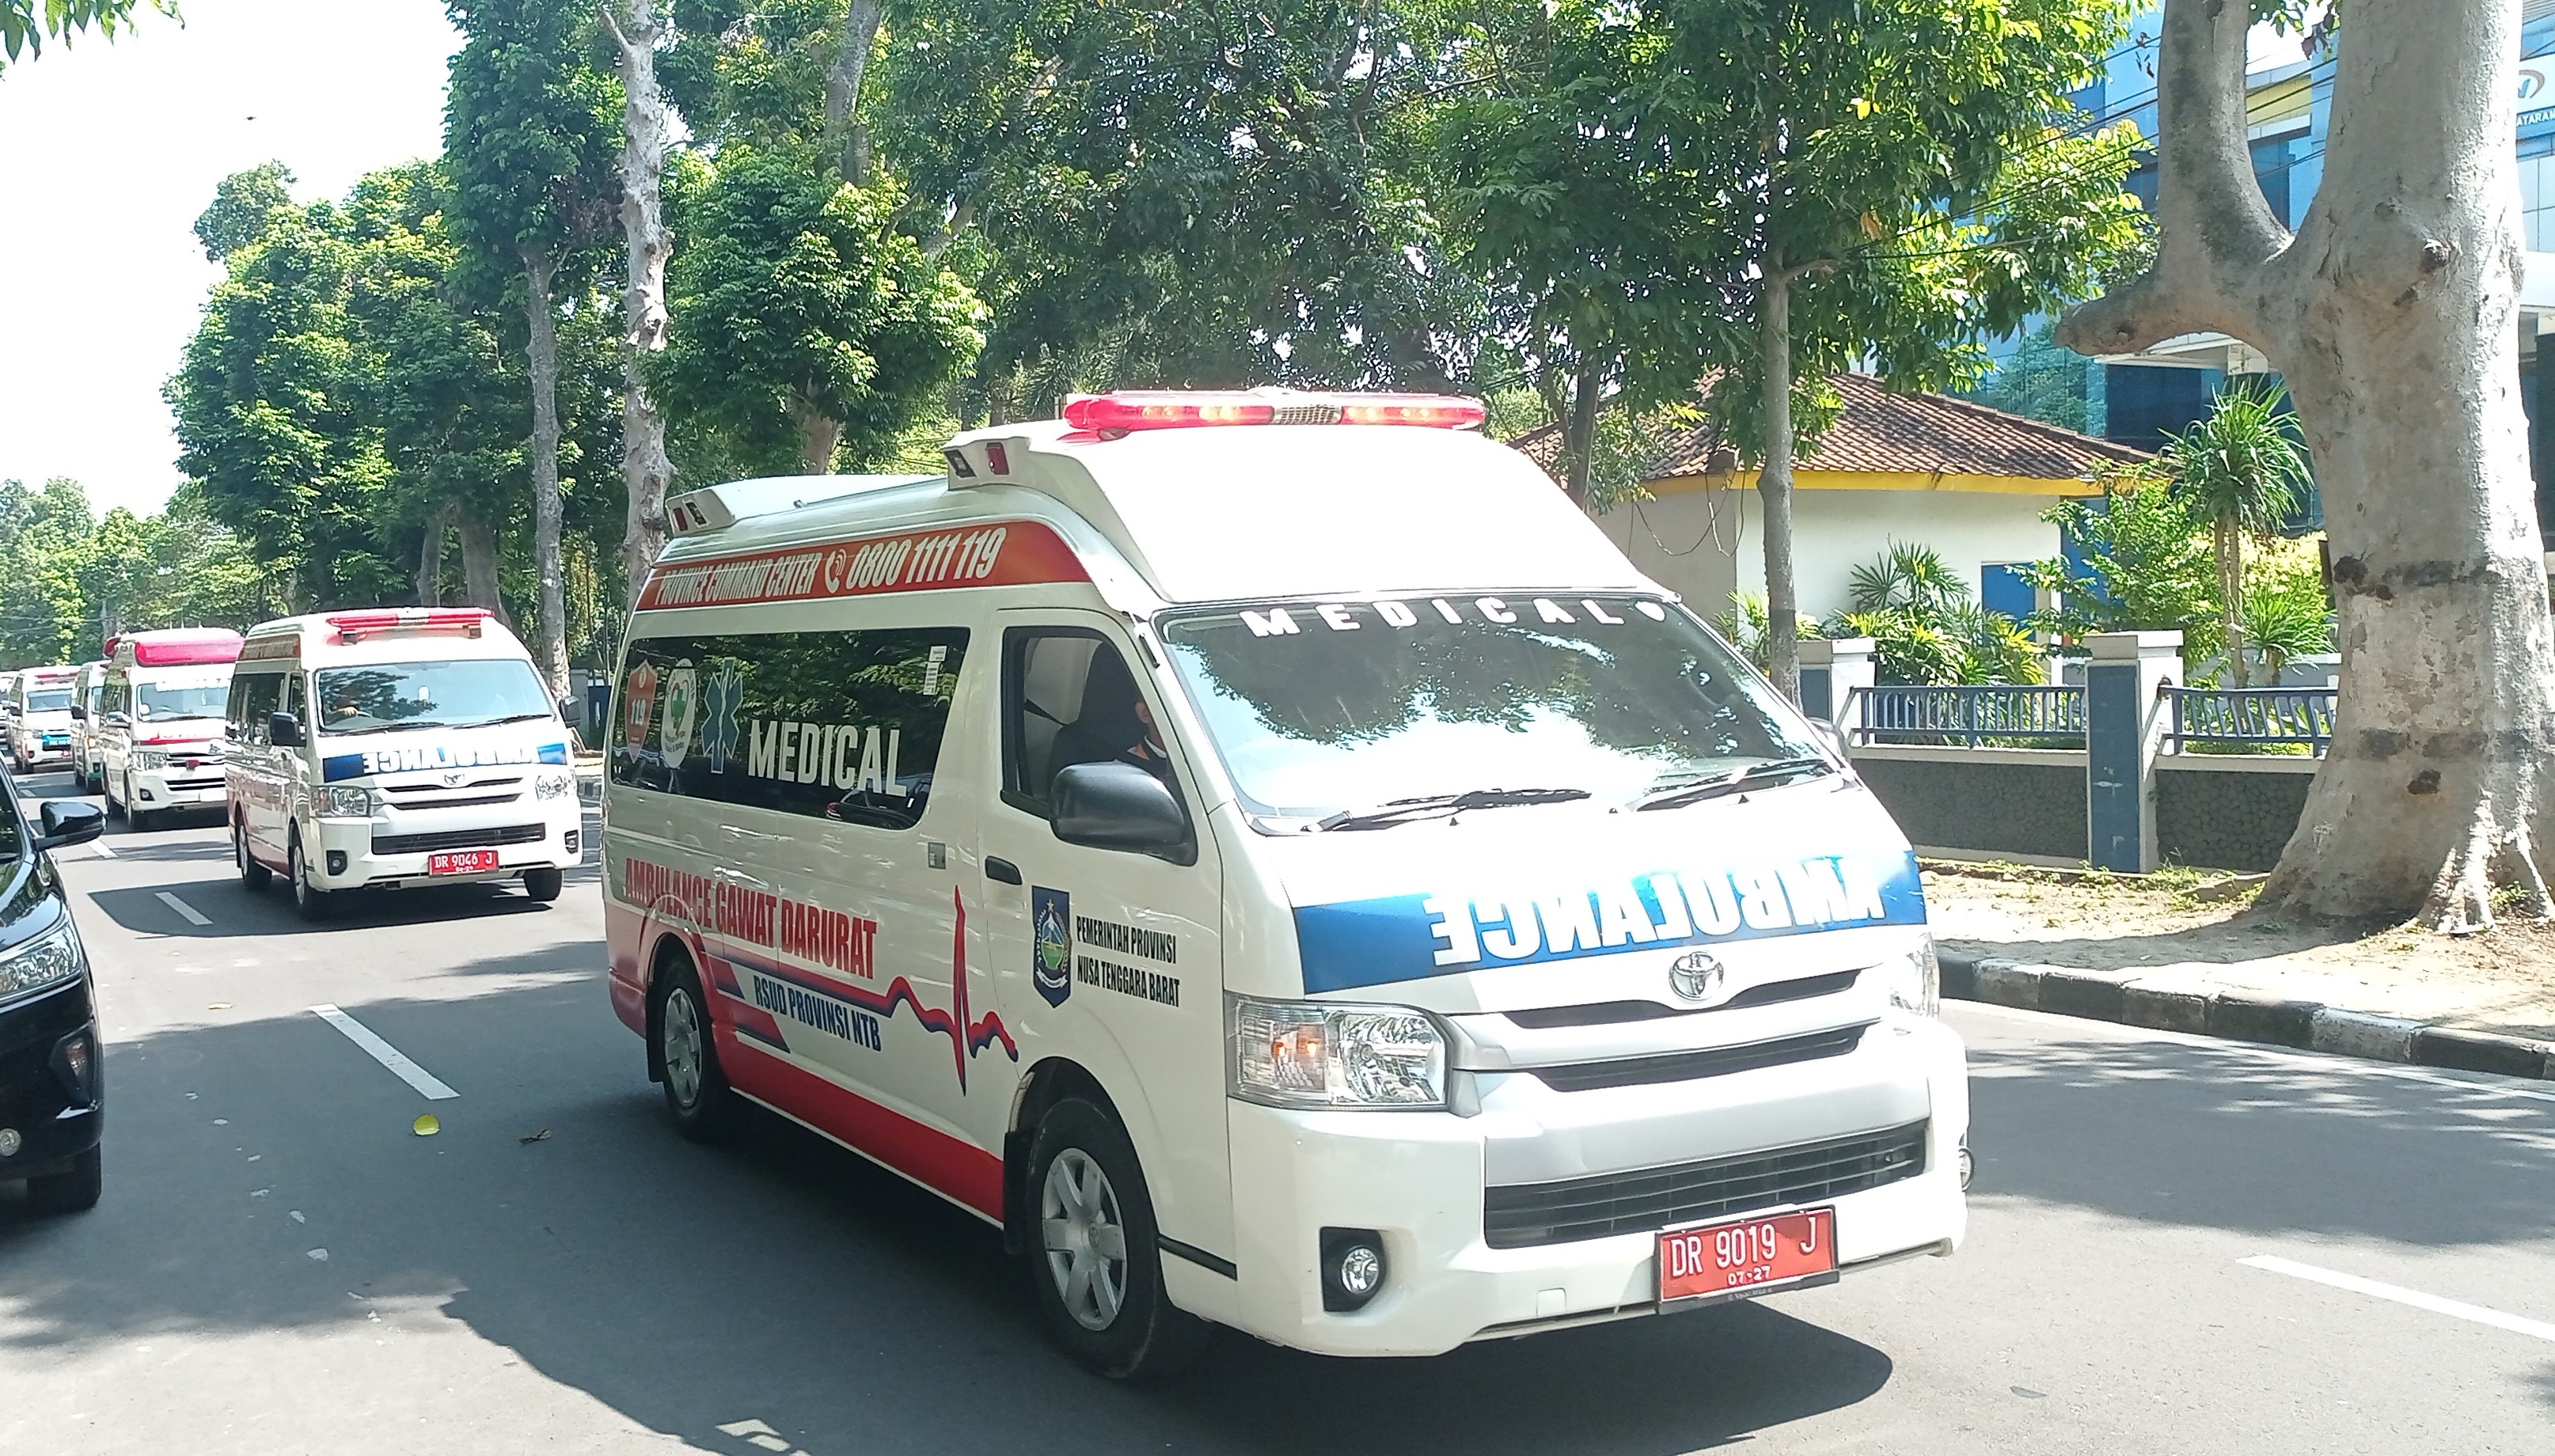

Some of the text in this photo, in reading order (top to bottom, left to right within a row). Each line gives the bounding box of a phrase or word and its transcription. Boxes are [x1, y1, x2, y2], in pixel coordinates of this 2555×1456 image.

[655, 527, 1008, 606] PROVINCE COMMAND CENTER 0800 1111 119
[1239, 597, 1625, 638] MEDICAL
[748, 719, 908, 798] MEDICAL
[435, 855, 450, 869] DR
[485, 852, 493, 864] J
[625, 858, 877, 980] AMBULANCE GAWAT DARURAT
[1076, 916, 1177, 964] PEMERINTAH PROVINSI
[1077, 954, 1180, 1007] NUSA TENGGARA BARAT
[754, 974, 882, 1052] RSUD PROVINSI NTB
[1670, 1216, 1817, 1277] DR 9019 J
